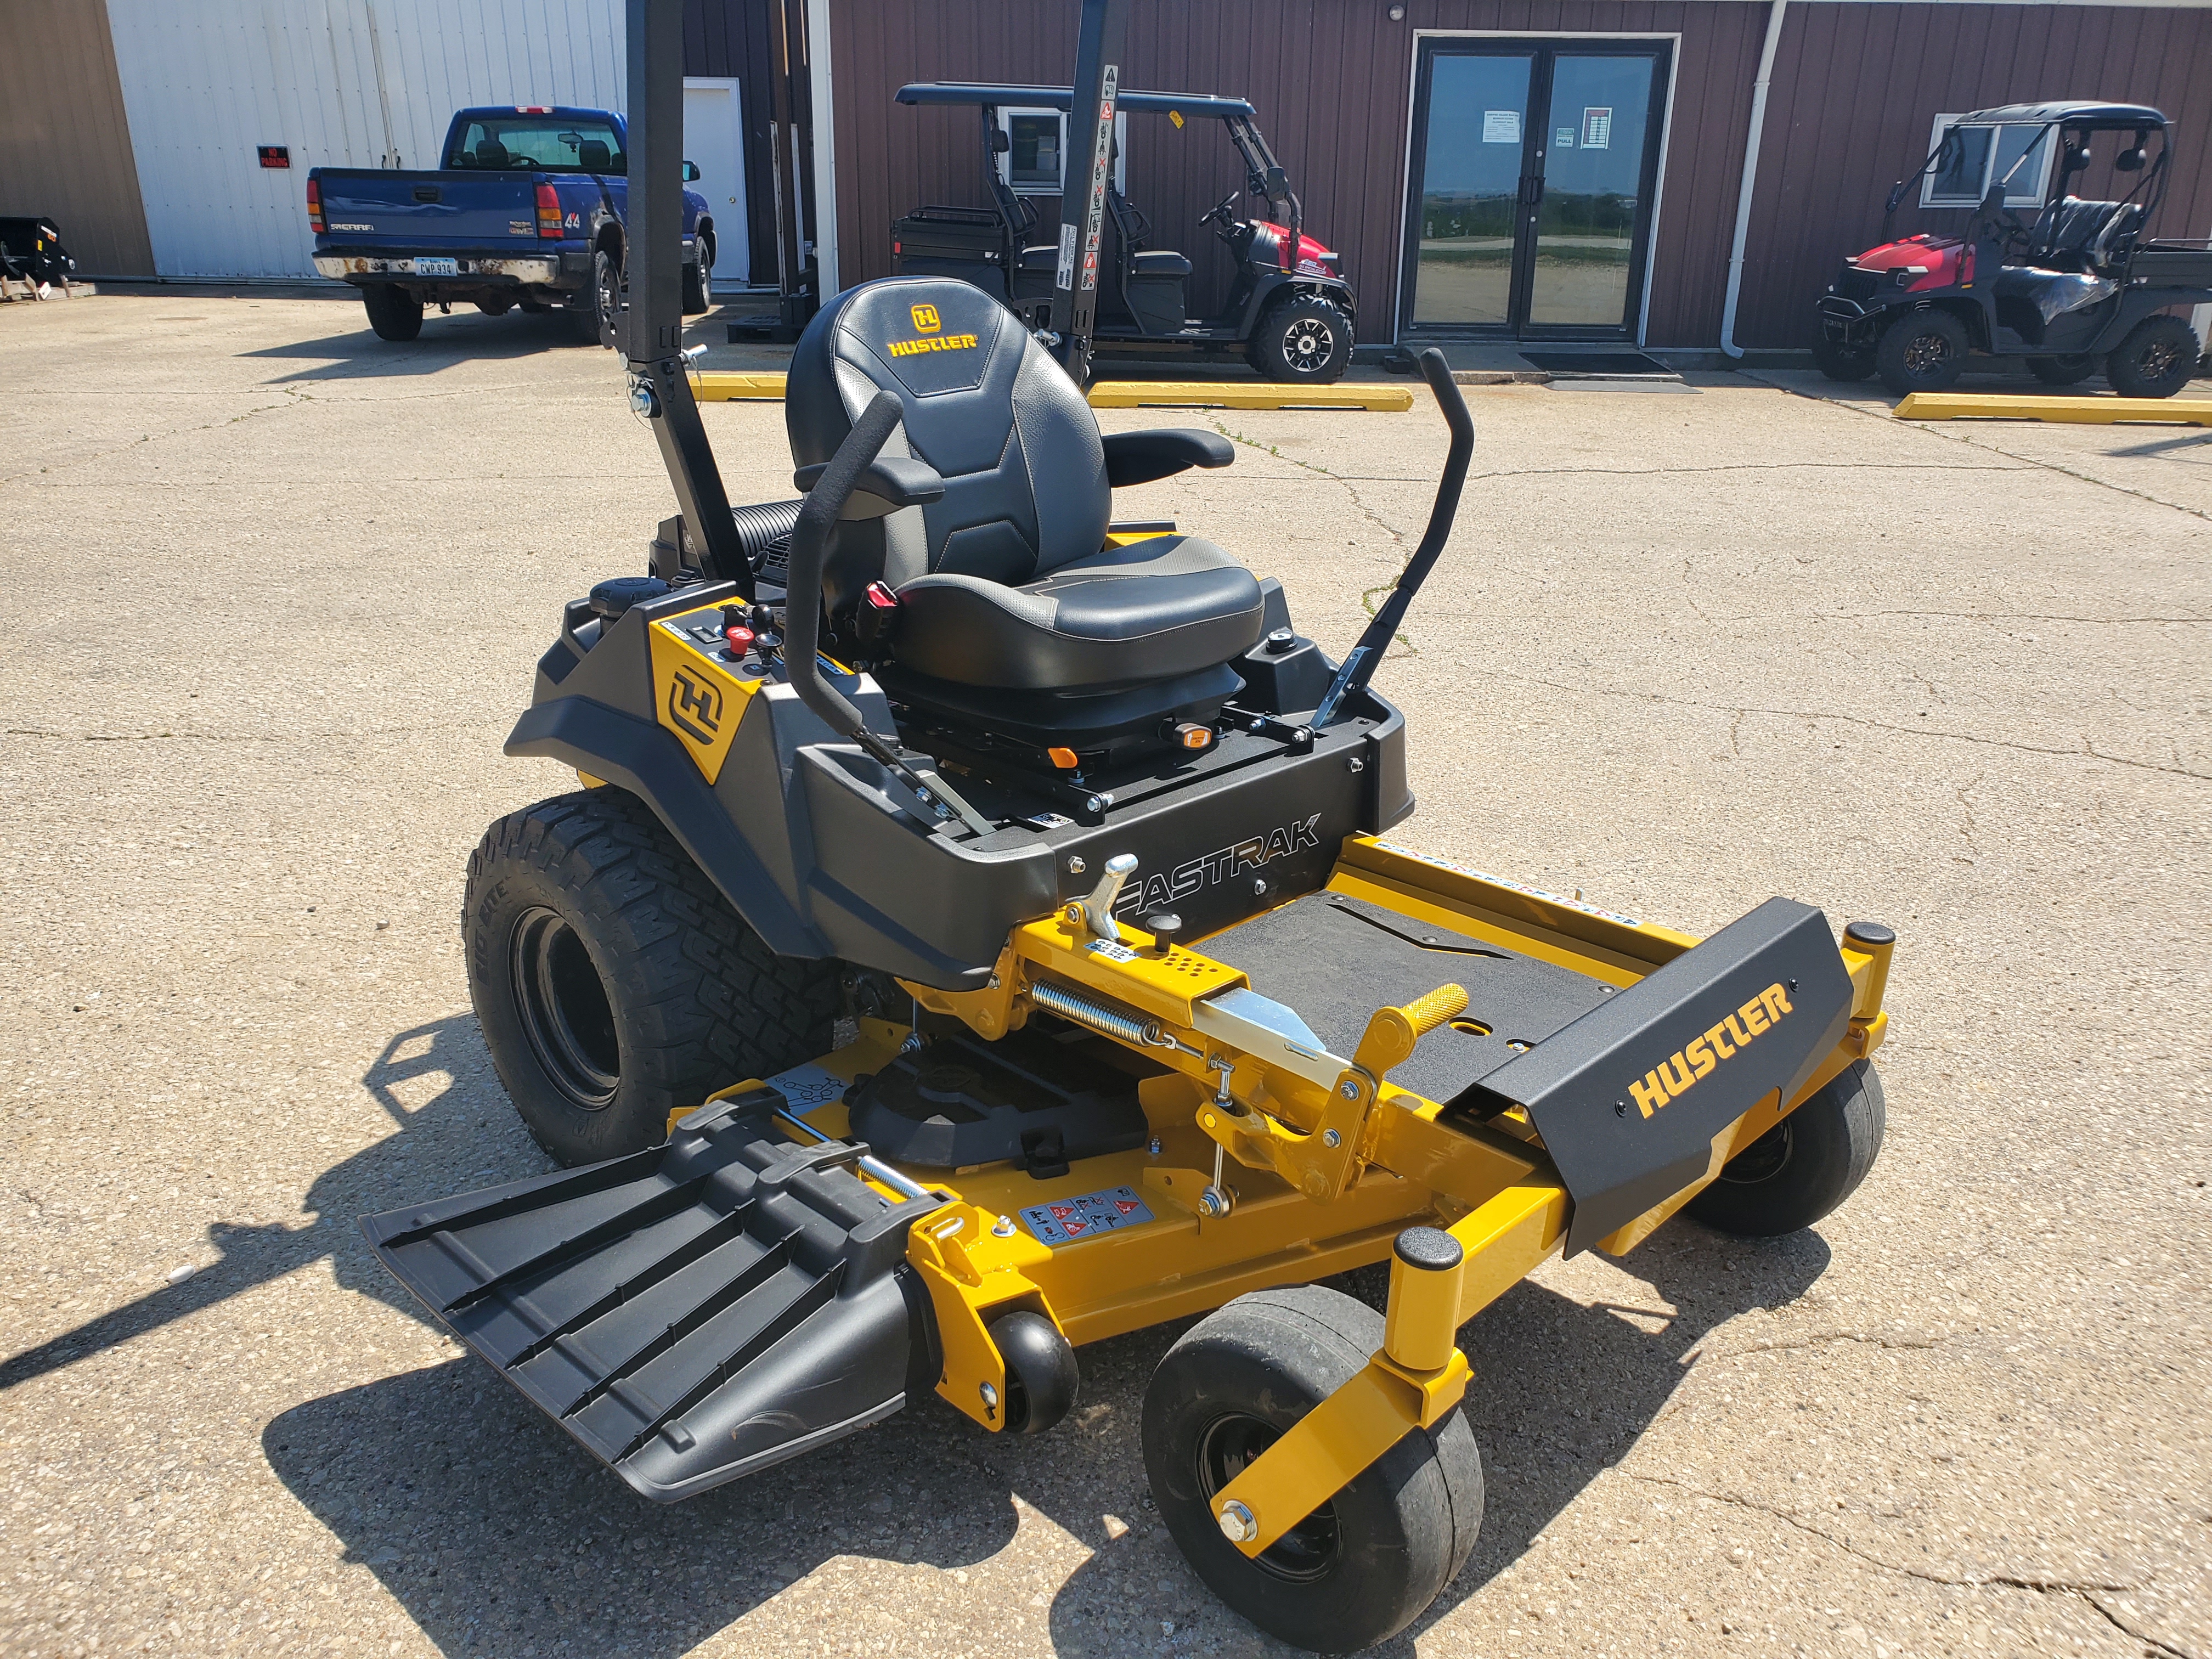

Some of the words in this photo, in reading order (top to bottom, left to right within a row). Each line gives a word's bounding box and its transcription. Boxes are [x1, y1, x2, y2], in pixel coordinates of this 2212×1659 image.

[268, 148, 277, 157] NO
[261, 157, 288, 167] PARKING
[420, 264, 435, 274] CWP
[437, 264, 451, 274] 934
[887, 334, 977, 357] HUSTLER
[1628, 983, 1793, 1120] HUSTLER
